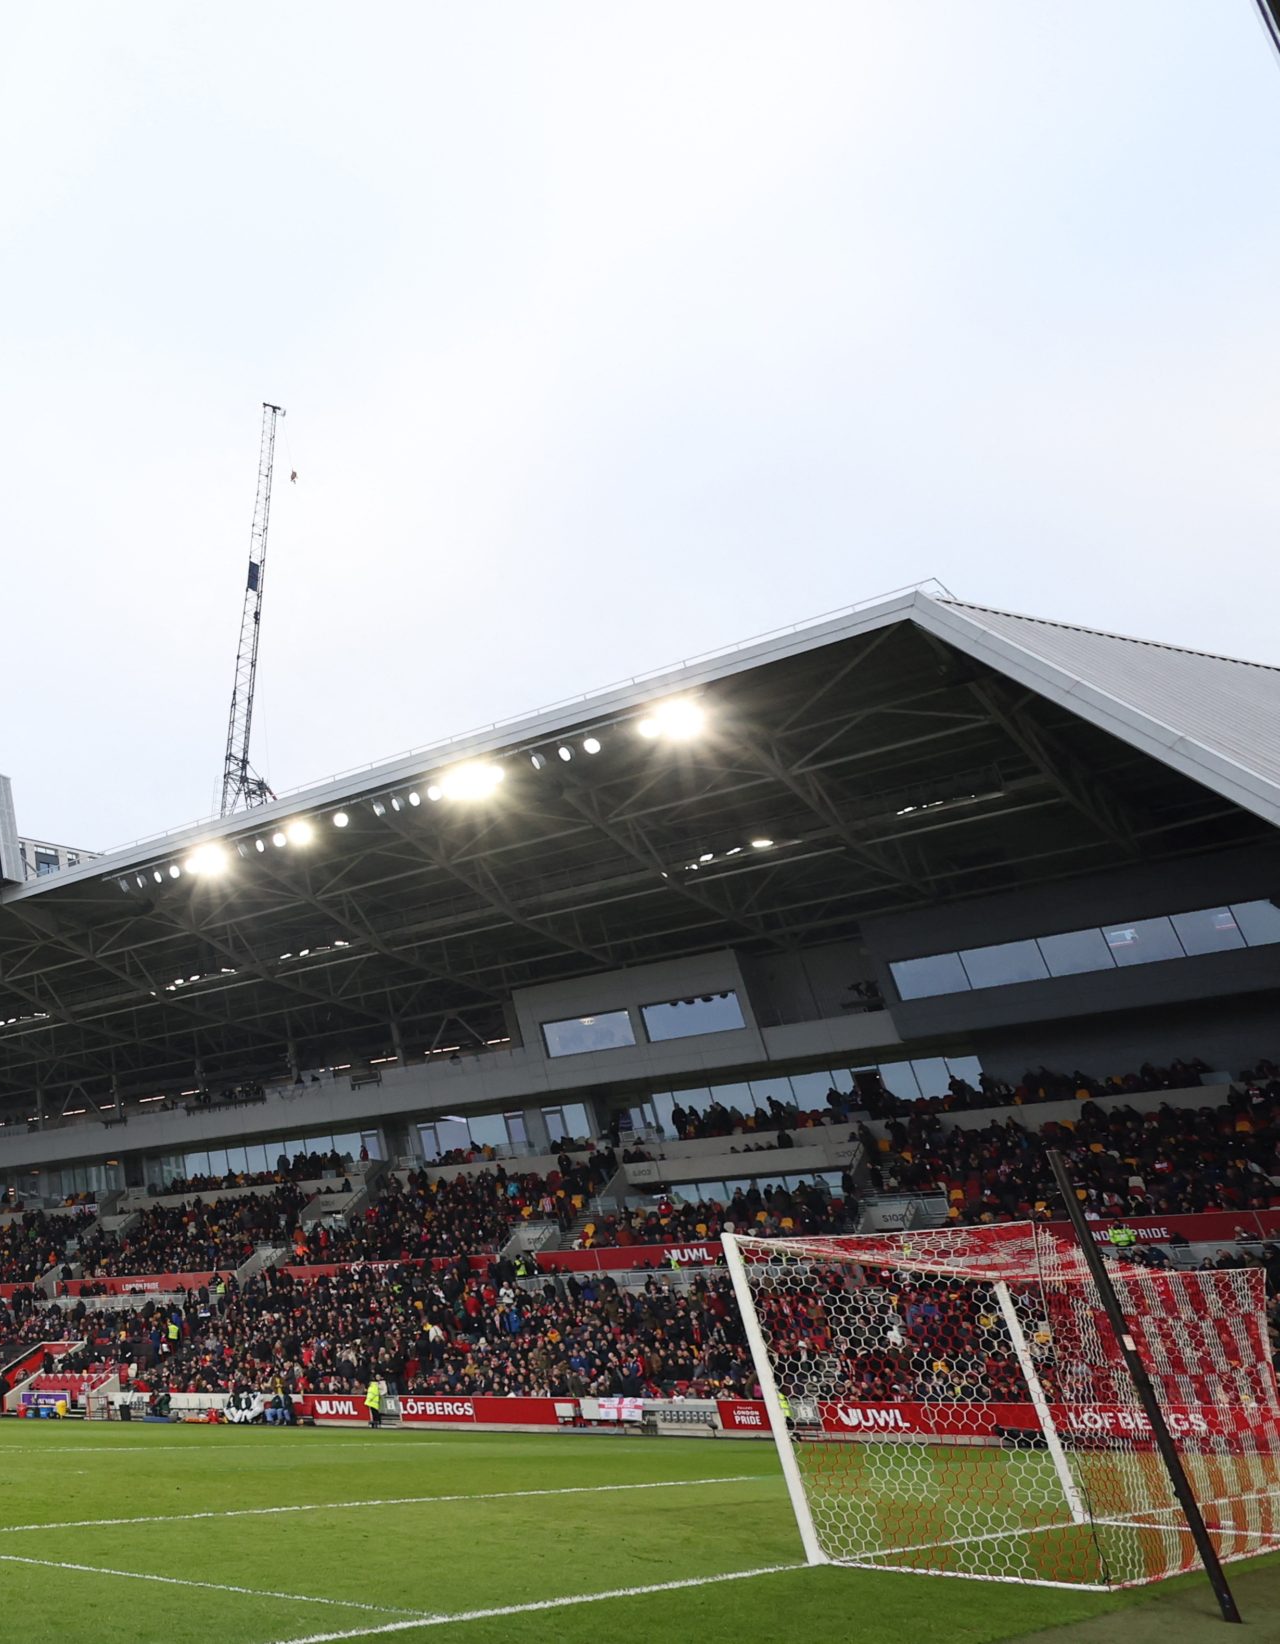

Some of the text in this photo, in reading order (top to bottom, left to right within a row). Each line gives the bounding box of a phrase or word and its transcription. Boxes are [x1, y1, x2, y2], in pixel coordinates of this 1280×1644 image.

[400, 1398, 474, 1416] LÖFBERGS
[734, 1416, 762, 1425] PRIDE
[1068, 1407, 1208, 1431] LÖFBEGS
